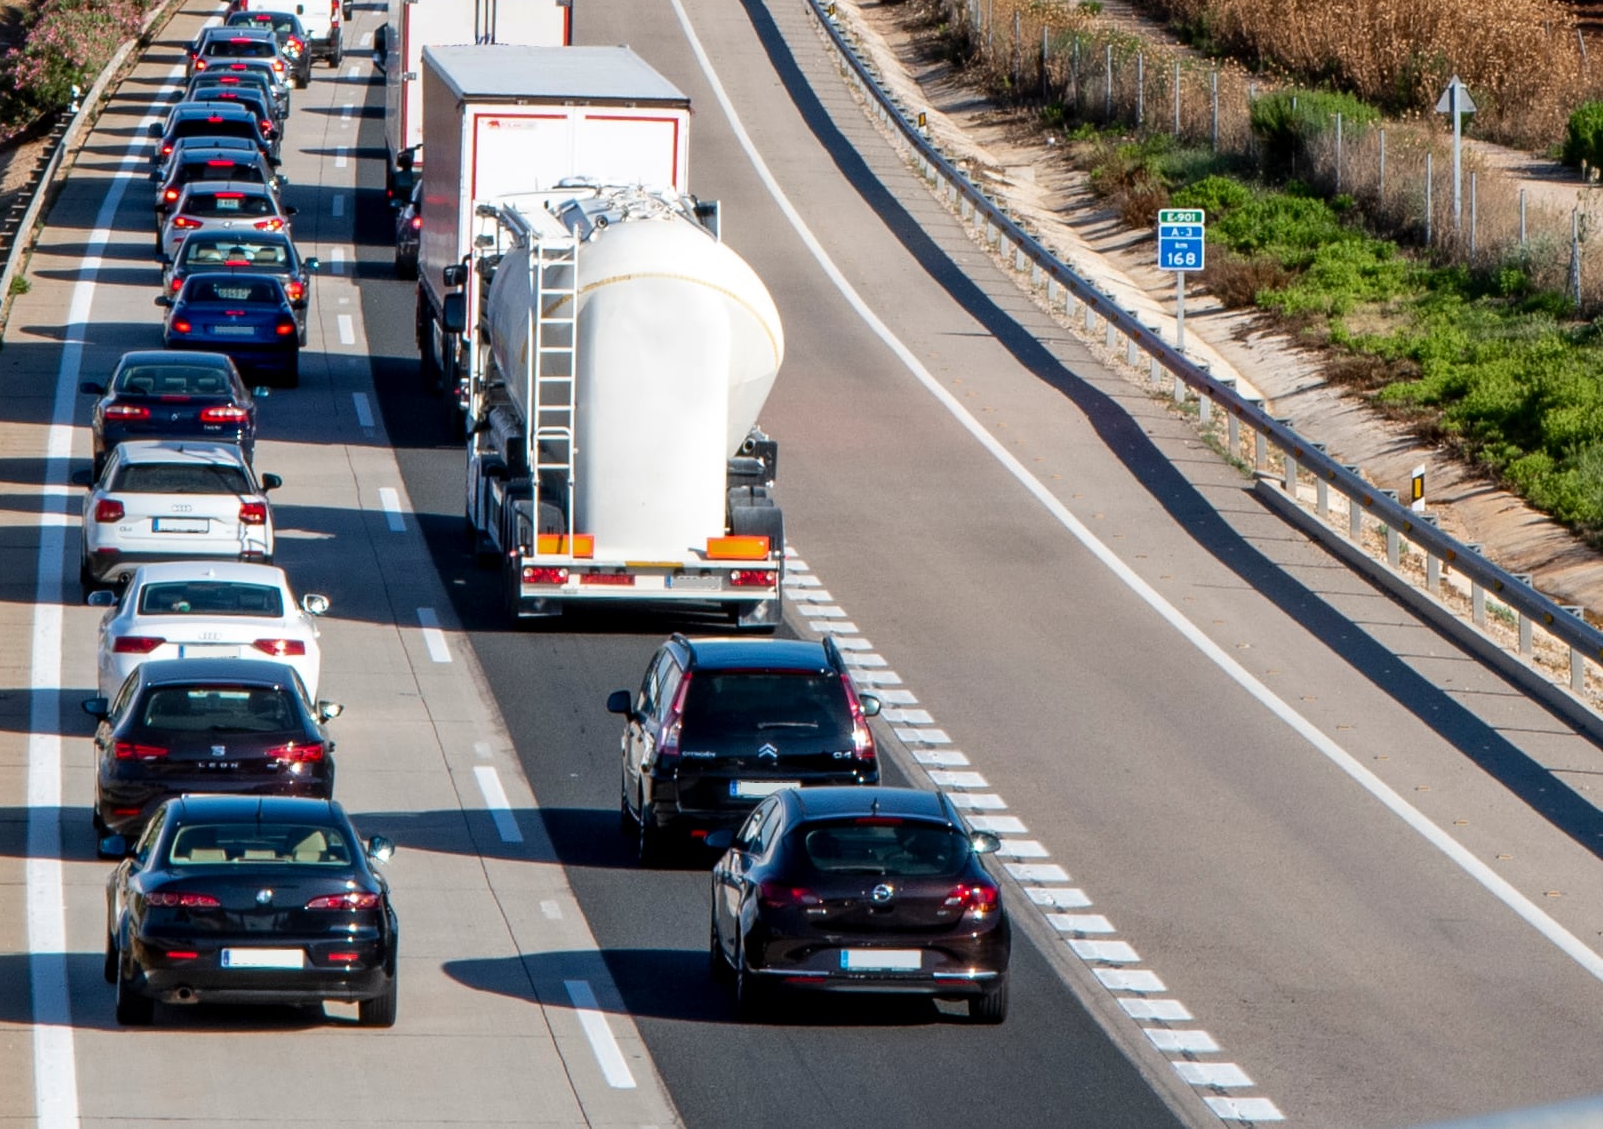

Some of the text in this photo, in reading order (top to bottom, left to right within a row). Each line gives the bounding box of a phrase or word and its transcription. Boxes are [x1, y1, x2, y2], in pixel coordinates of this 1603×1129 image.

[1167, 213, 1196, 222] E-901
[1171, 228, 1193, 237] A-3
[1167, 252, 1196, 266] 168
